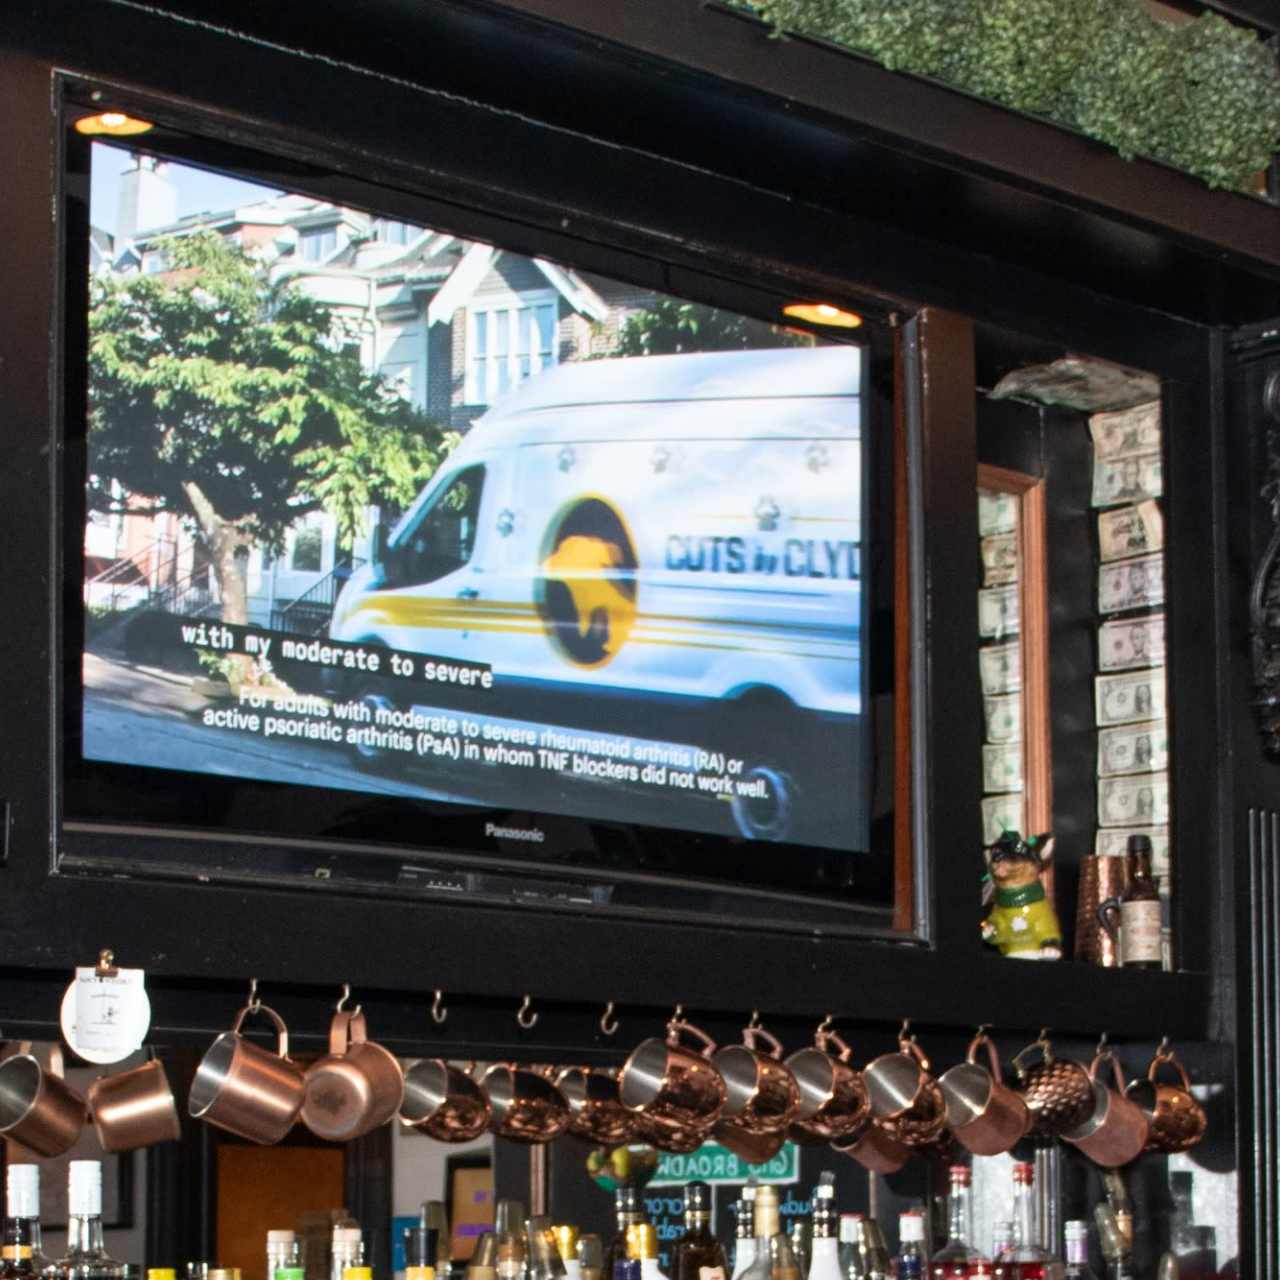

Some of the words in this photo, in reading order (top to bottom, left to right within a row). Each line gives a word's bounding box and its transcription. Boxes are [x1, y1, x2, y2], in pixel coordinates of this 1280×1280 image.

[666, 535, 745, 574] CUTS
[181, 624, 234, 649] with
[245, 635, 272, 659] my
[282, 639, 380, 671] moderate
[390, 653, 414, 677] to
[424, 661, 494, 689] severe
[203, 707, 261, 731] active
[264, 714, 343, 742] psoriatic
[346, 726, 414, 752] arthritis
[416, 731, 460, 761] (PsA)
[464, 740, 480, 760] in
[483, 743, 534, 767] whom
[537, 750, 569, 772] TNF
[572, 755, 639, 782] blockers
[641, 764, 666, 785] did
[669, 770, 695, 790] not
[697, 773, 734, 795] work
[736, 779, 769, 800] well.
[239, 686, 268, 708] For
[273, 691, 329, 718] adults
[333, 700, 372, 723] with
[375, 703, 457, 735] moderate
[462, 719, 480, 737] to
[483, 724, 536, 745] severe
[540, 727, 631, 759] rheumatoid
[632, 743, 691, 768] arthritis
[693, 750, 725, 774] (RA)
[727, 758, 744, 775] or
[485, 822, 545, 843] Panasonic
